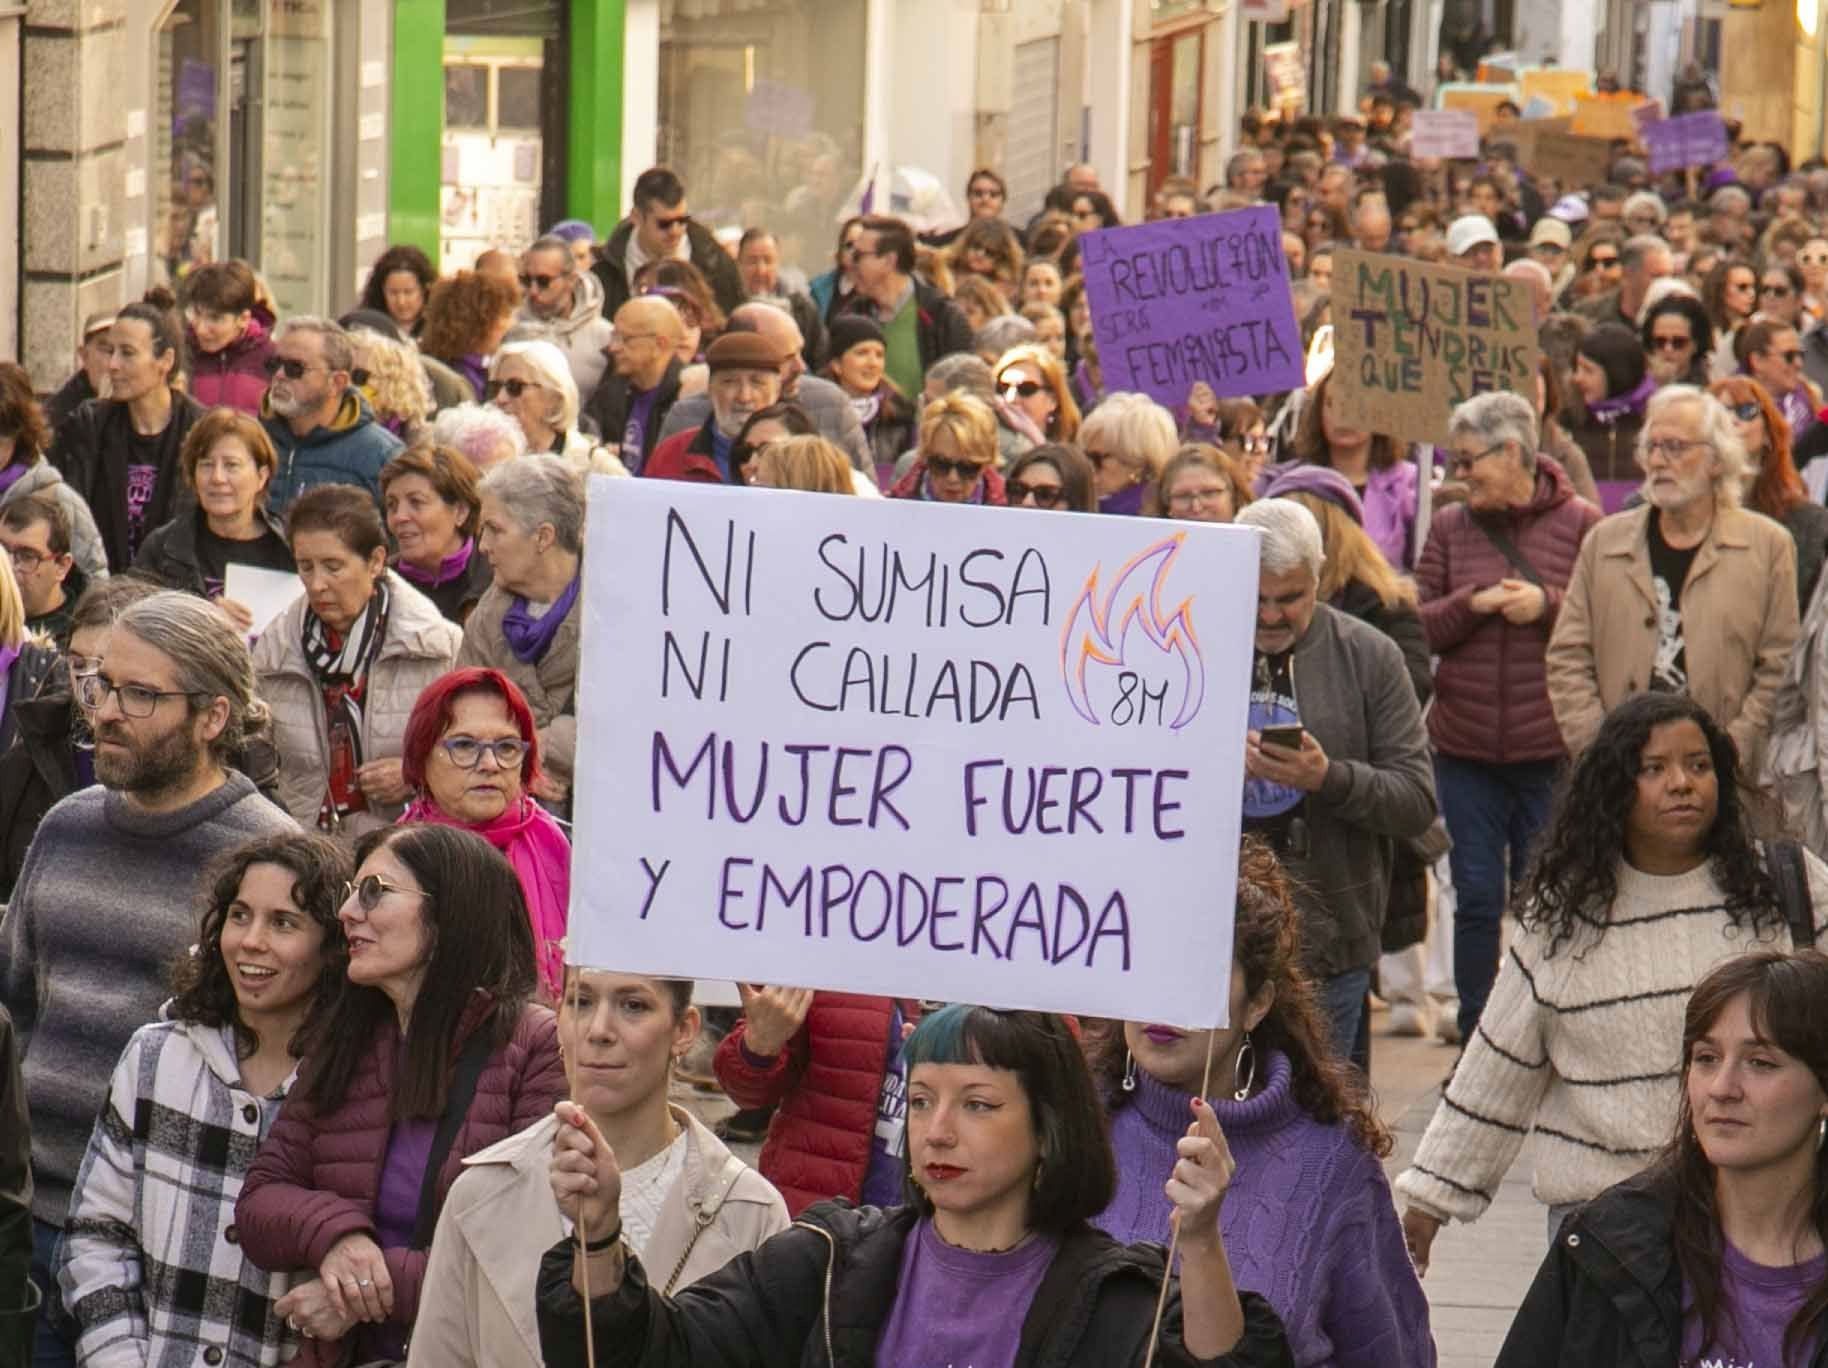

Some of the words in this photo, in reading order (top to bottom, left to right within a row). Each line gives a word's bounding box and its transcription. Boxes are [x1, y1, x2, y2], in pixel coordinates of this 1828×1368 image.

[1109, 219, 1281, 302] REVOLUCIÓN
[1357, 262, 1518, 331] MUJER
[1126, 318, 1291, 389] FEMINISTA
[1361, 353, 1423, 393] QUE
[663, 507, 755, 616] NI
[814, 534, 1050, 627] SUMISA
[662, 631, 731, 702] NI
[790, 641, 1040, 723] CALLADA
[1110, 671, 1170, 726] 8M
[652, 730, 912, 830] MUJER
[963, 759, 1189, 839] FUERTE
[718, 857, 1131, 972] EMPODERADA
